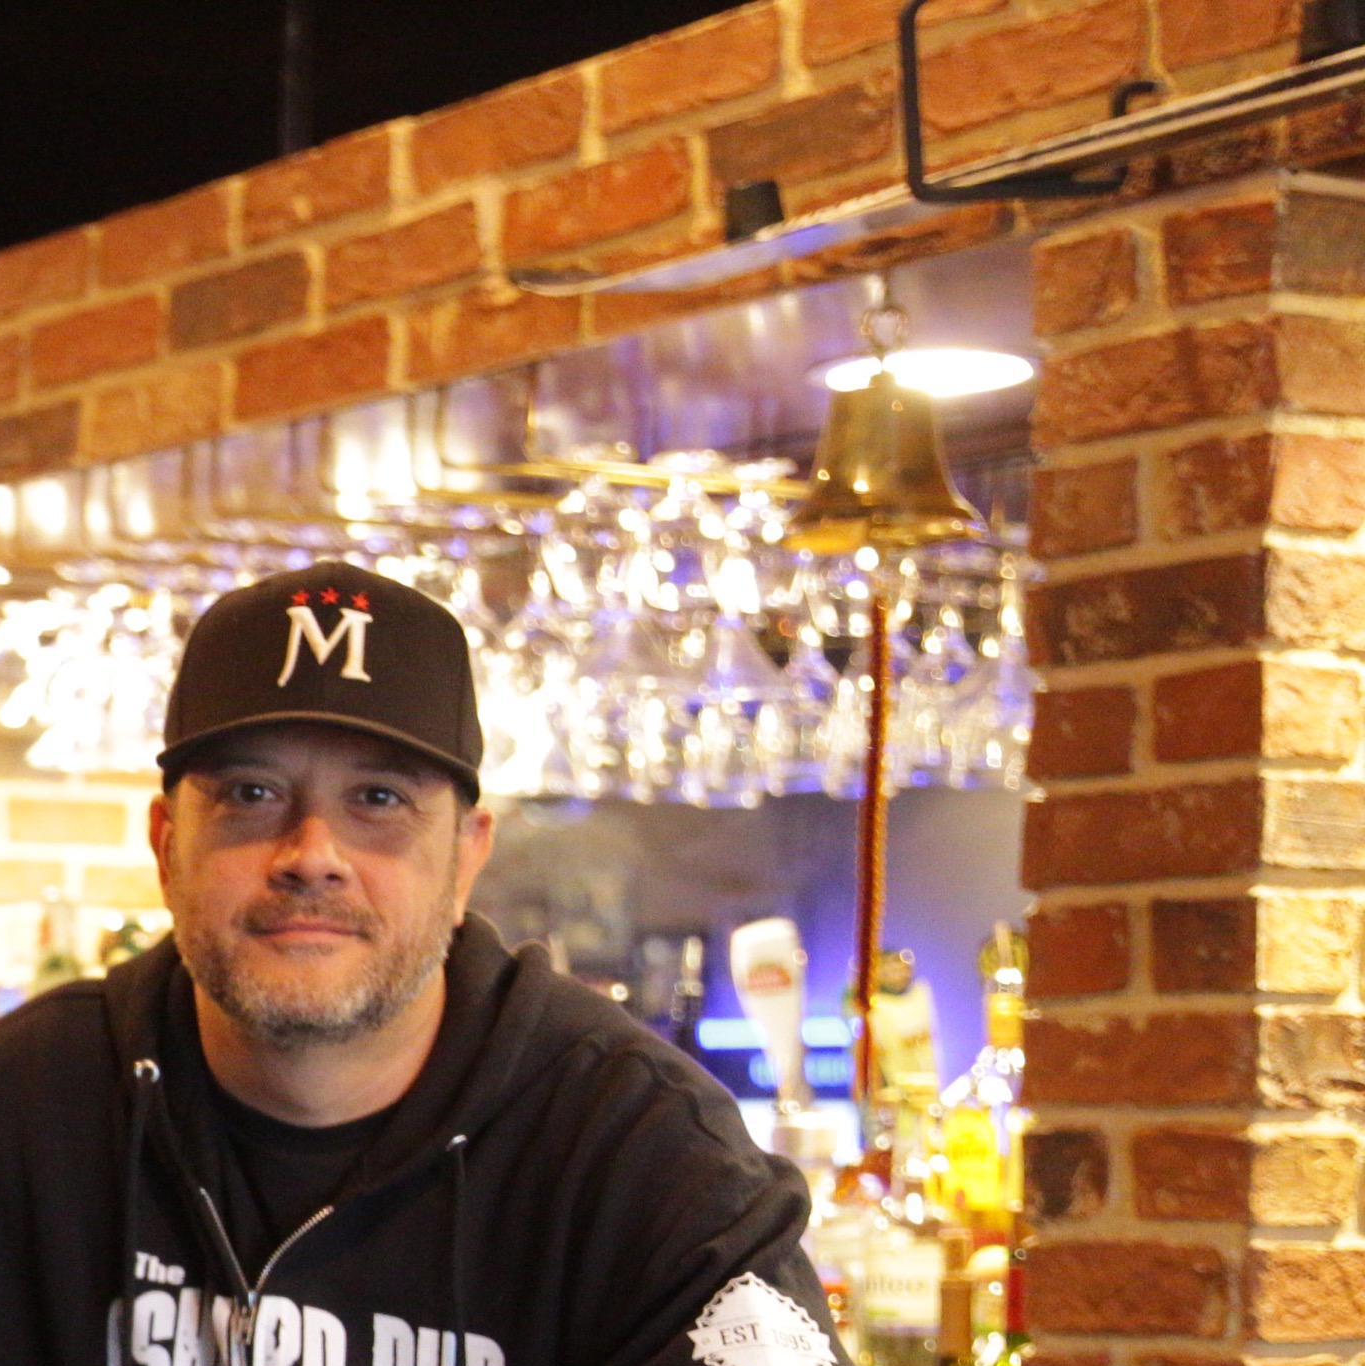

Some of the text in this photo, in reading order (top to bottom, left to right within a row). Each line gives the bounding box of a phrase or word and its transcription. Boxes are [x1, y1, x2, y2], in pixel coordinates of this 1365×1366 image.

[278, 604, 373, 688] M
[134, 1252, 186, 1286] The
[719, 1322, 813, 1352] EST 1995
